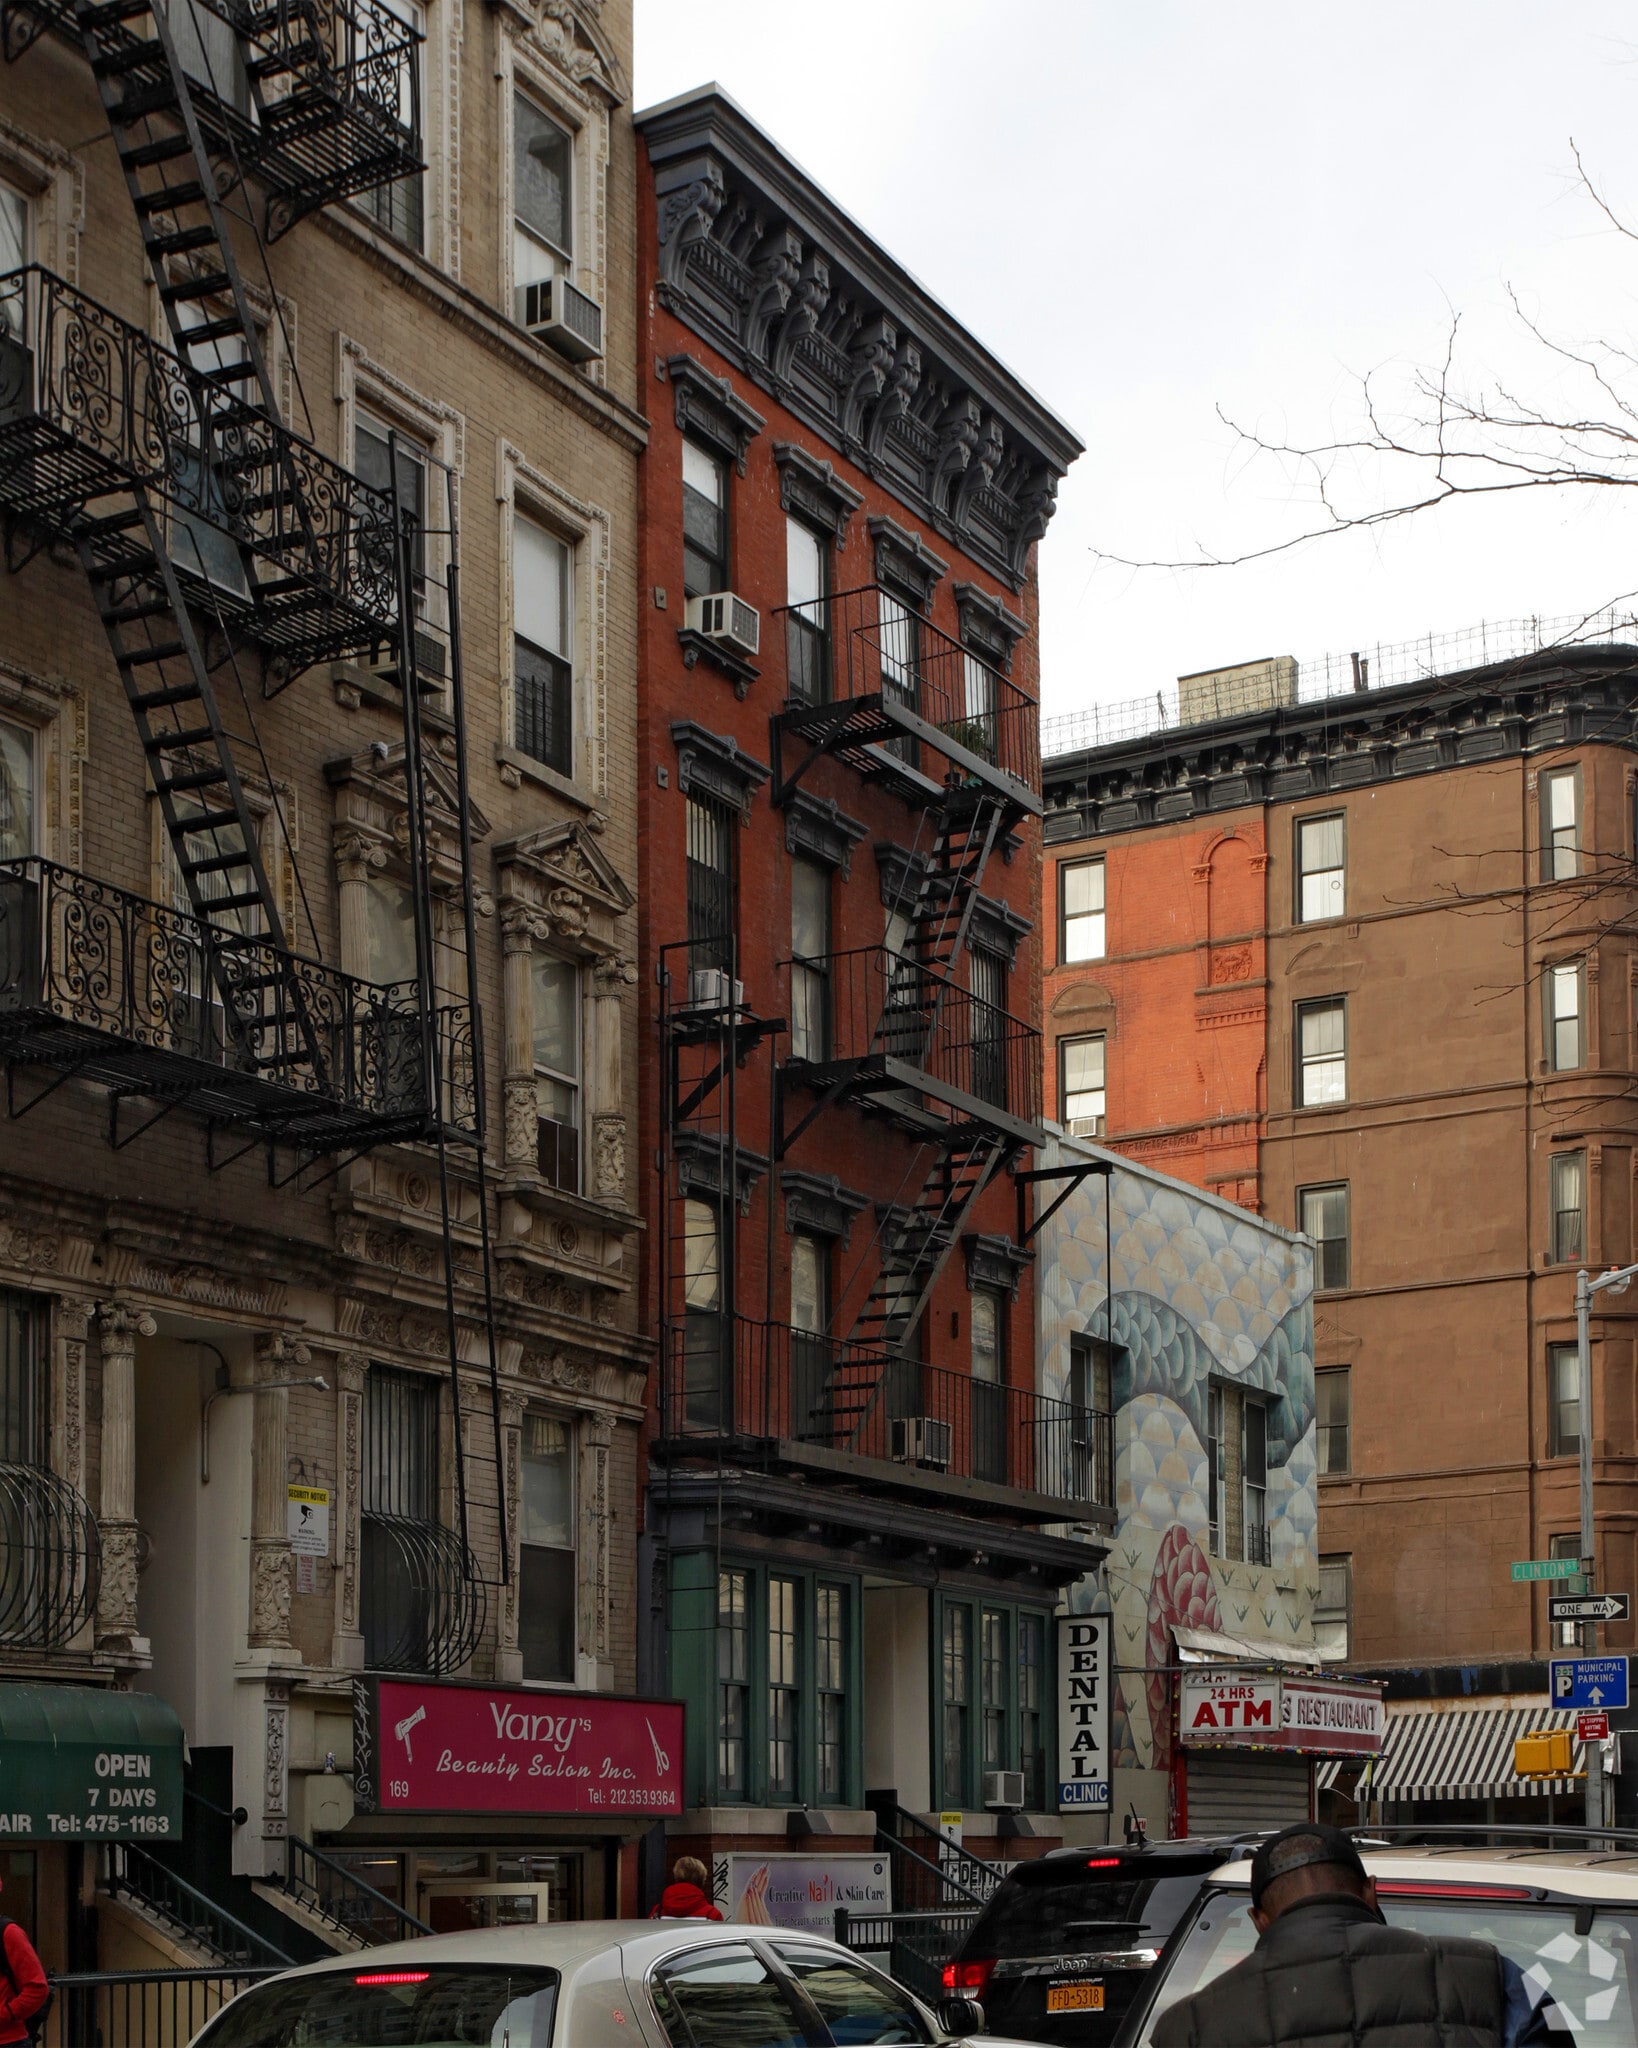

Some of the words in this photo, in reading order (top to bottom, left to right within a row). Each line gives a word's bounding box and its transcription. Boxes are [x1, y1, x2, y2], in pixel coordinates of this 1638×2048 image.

[1513, 1562, 1565, 1579] CLINTON
[1566, 1561, 1577, 1569] ST
[1559, 1604, 1582, 1615] ONE
[1593, 1603, 1616, 1613] WAY
[1577, 1662, 1623, 1673] MUNICIPAL
[1556, 1676, 1572, 1697] P
[1577, 1673, 1615, 1684] PARKING
[1068, 1624, 1100, 1779] DENTAL
[1210, 1688, 1225, 1700] 24
[1229, 1687, 1255, 1699] HRS
[1191, 1699, 1272, 1728] ATM
[1297, 1697, 1378, 1731] RESTAURANT
[489, 1702, 592, 1753] Yany's
[94, 1753, 151, 1778] OPEN
[436, 1749, 519, 1782] Beauty
[527, 1753, 591, 1777] Salon
[598, 1756, 637, 1780] Inc.
[88, 1788, 100, 1807] 7
[108, 1788, 157, 1808] DAYS
[389, 1780, 409, 1798] 169
[588, 1787, 606, 1804] Tel:
[610, 1788, 676, 1805] 212.353.9364
[1063, 1784, 1108, 1803] CLINIC
[47, 1813, 82, 1833] Tel:
[84, 1814, 170, 1834] 475-1163
[768, 1885, 805, 1903] Creative
[808, 1874, 834, 1903] Nail
[836, 1884, 843, 1901] &
[845, 1884, 864, 1901] Skin
[865, 1884, 885, 1901] Care
[1053, 1958, 1088, 1972] Jeep
